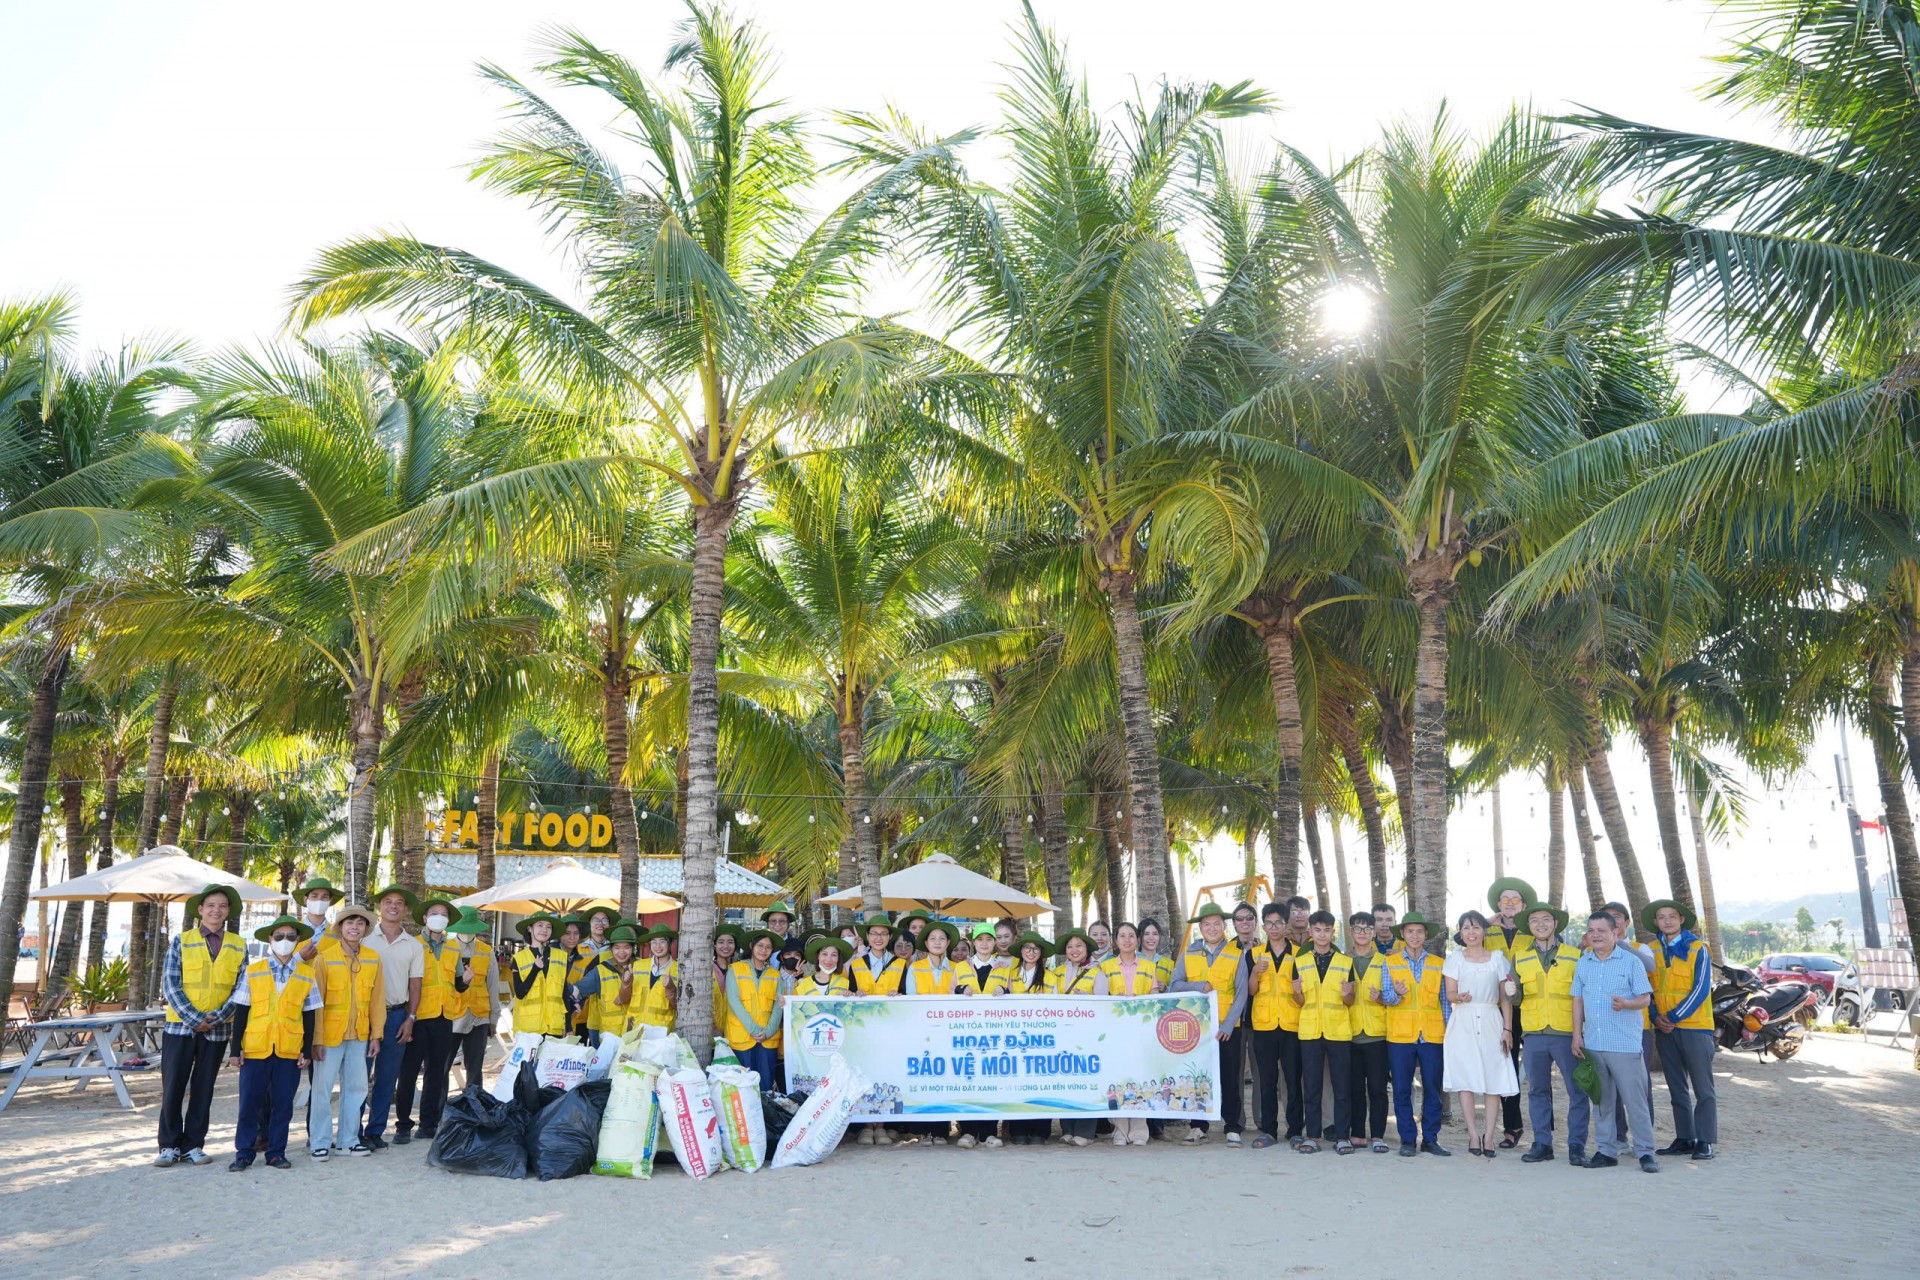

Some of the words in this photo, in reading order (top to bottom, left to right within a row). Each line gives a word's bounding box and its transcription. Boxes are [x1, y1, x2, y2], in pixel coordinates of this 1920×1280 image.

[443, 810, 517, 845] FAT
[524, 812, 613, 847] FOOD
[926, 1009, 945, 1019] CLB
[947, 1009, 975, 1019] GĐHP
[985, 1009, 1018, 1020] PHỤNG
[1020, 1007, 1033, 1020] SỰ
[1035, 1007, 1064, 1020] CỘNG
[1005, 1021, 1021, 1029] YÊU
[952, 1034, 1000, 1053] HOẠT
[1004, 1031, 1055, 1053] ĐỘNG
[907, 1051, 946, 1076] BẢO
[951, 1052, 975, 1080] VỆ
[981, 1052, 1018, 1076] MÔI
[1022, 1051, 1101, 1075] TRƯỜNG
[978, 1084, 997, 1092] XANH
